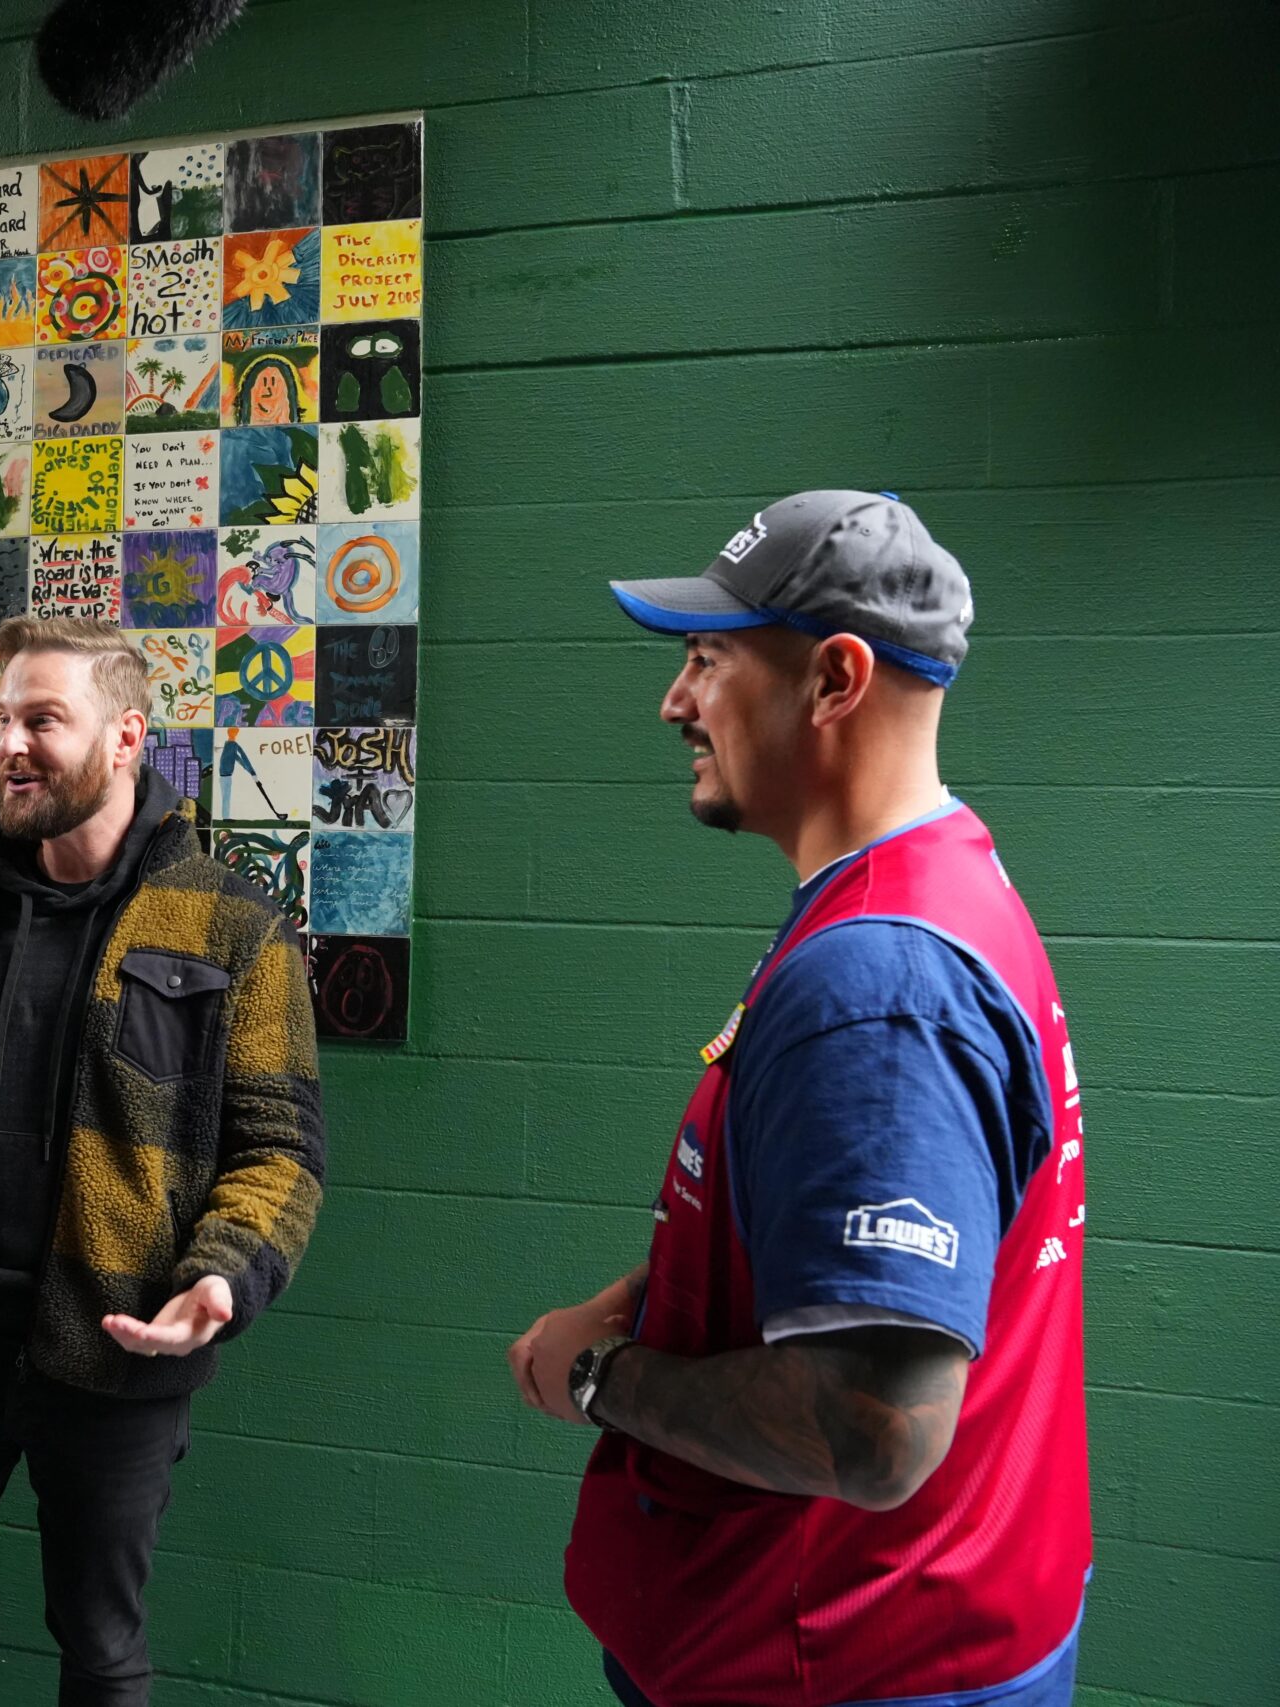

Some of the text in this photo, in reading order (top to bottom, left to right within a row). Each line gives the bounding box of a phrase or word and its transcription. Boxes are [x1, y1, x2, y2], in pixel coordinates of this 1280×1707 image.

[157, 271, 187, 298] 2
[340, 273, 413, 287] PROJECT
[333, 290, 420, 309] JULY 2005
[130, 301, 185, 336] hot
[224, 333, 248, 349] My
[37, 343, 120, 361] DEDICATED
[70, 421, 121, 437] DADDY
[35, 441, 67, 457] You
[135, 459, 159, 470] NEED
[166, 458, 173, 468] A
[133, 482, 145, 491] IF
[134, 495, 194, 506] KNOW WHERE
[159, 506, 186, 515] WANT
[191, 505, 203, 513] TO
[218, 699, 314, 727] PEACE
[259, 733, 313, 756] FORE!
[858, 1213, 950, 1258] LOWE'S
